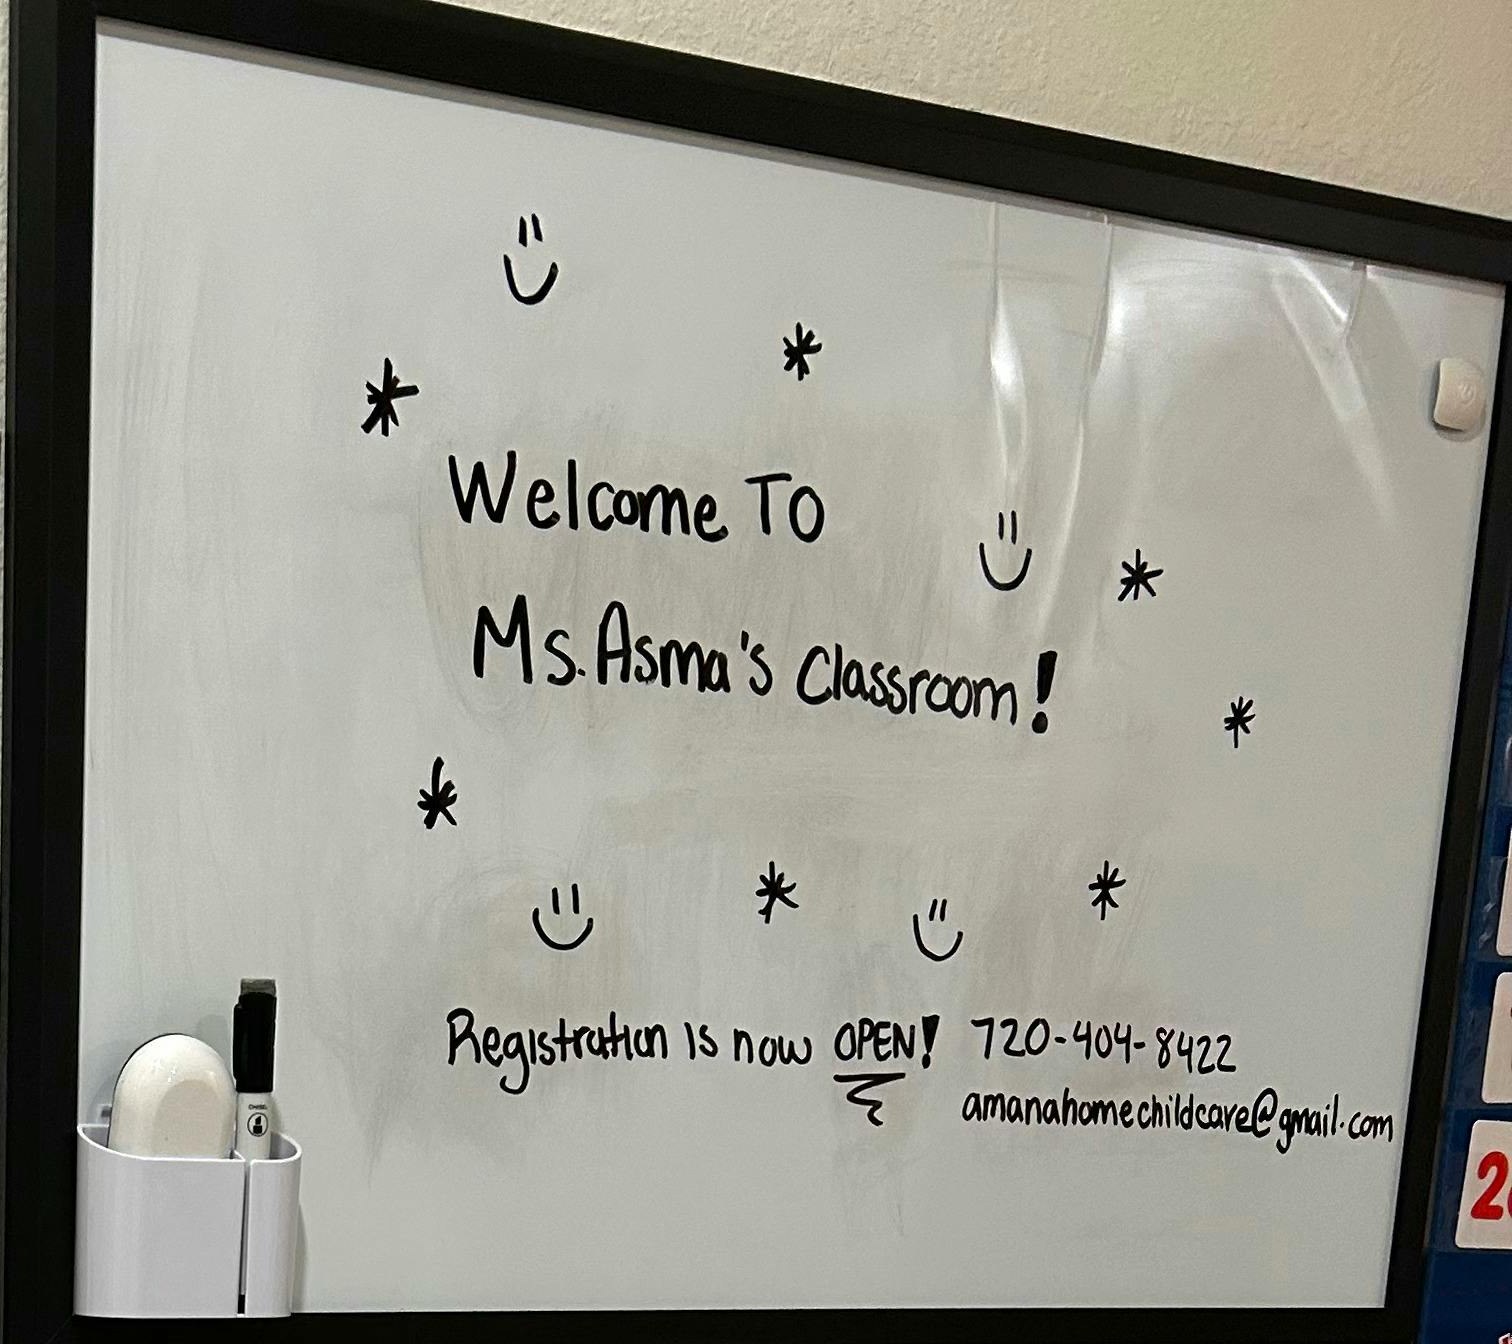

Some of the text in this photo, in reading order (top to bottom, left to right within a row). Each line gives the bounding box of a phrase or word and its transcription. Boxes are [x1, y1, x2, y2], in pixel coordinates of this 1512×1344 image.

[447, 450, 729, 544] Welcome
[446, 1007, 669, 1095] Registration
[733, 1027, 813, 1067] now
[834, 1015, 940, 1069] OPEN!
[971, 1017, 1237, 1075] 720-404-8422
[1470, 1150, 1512, 1221] 2
